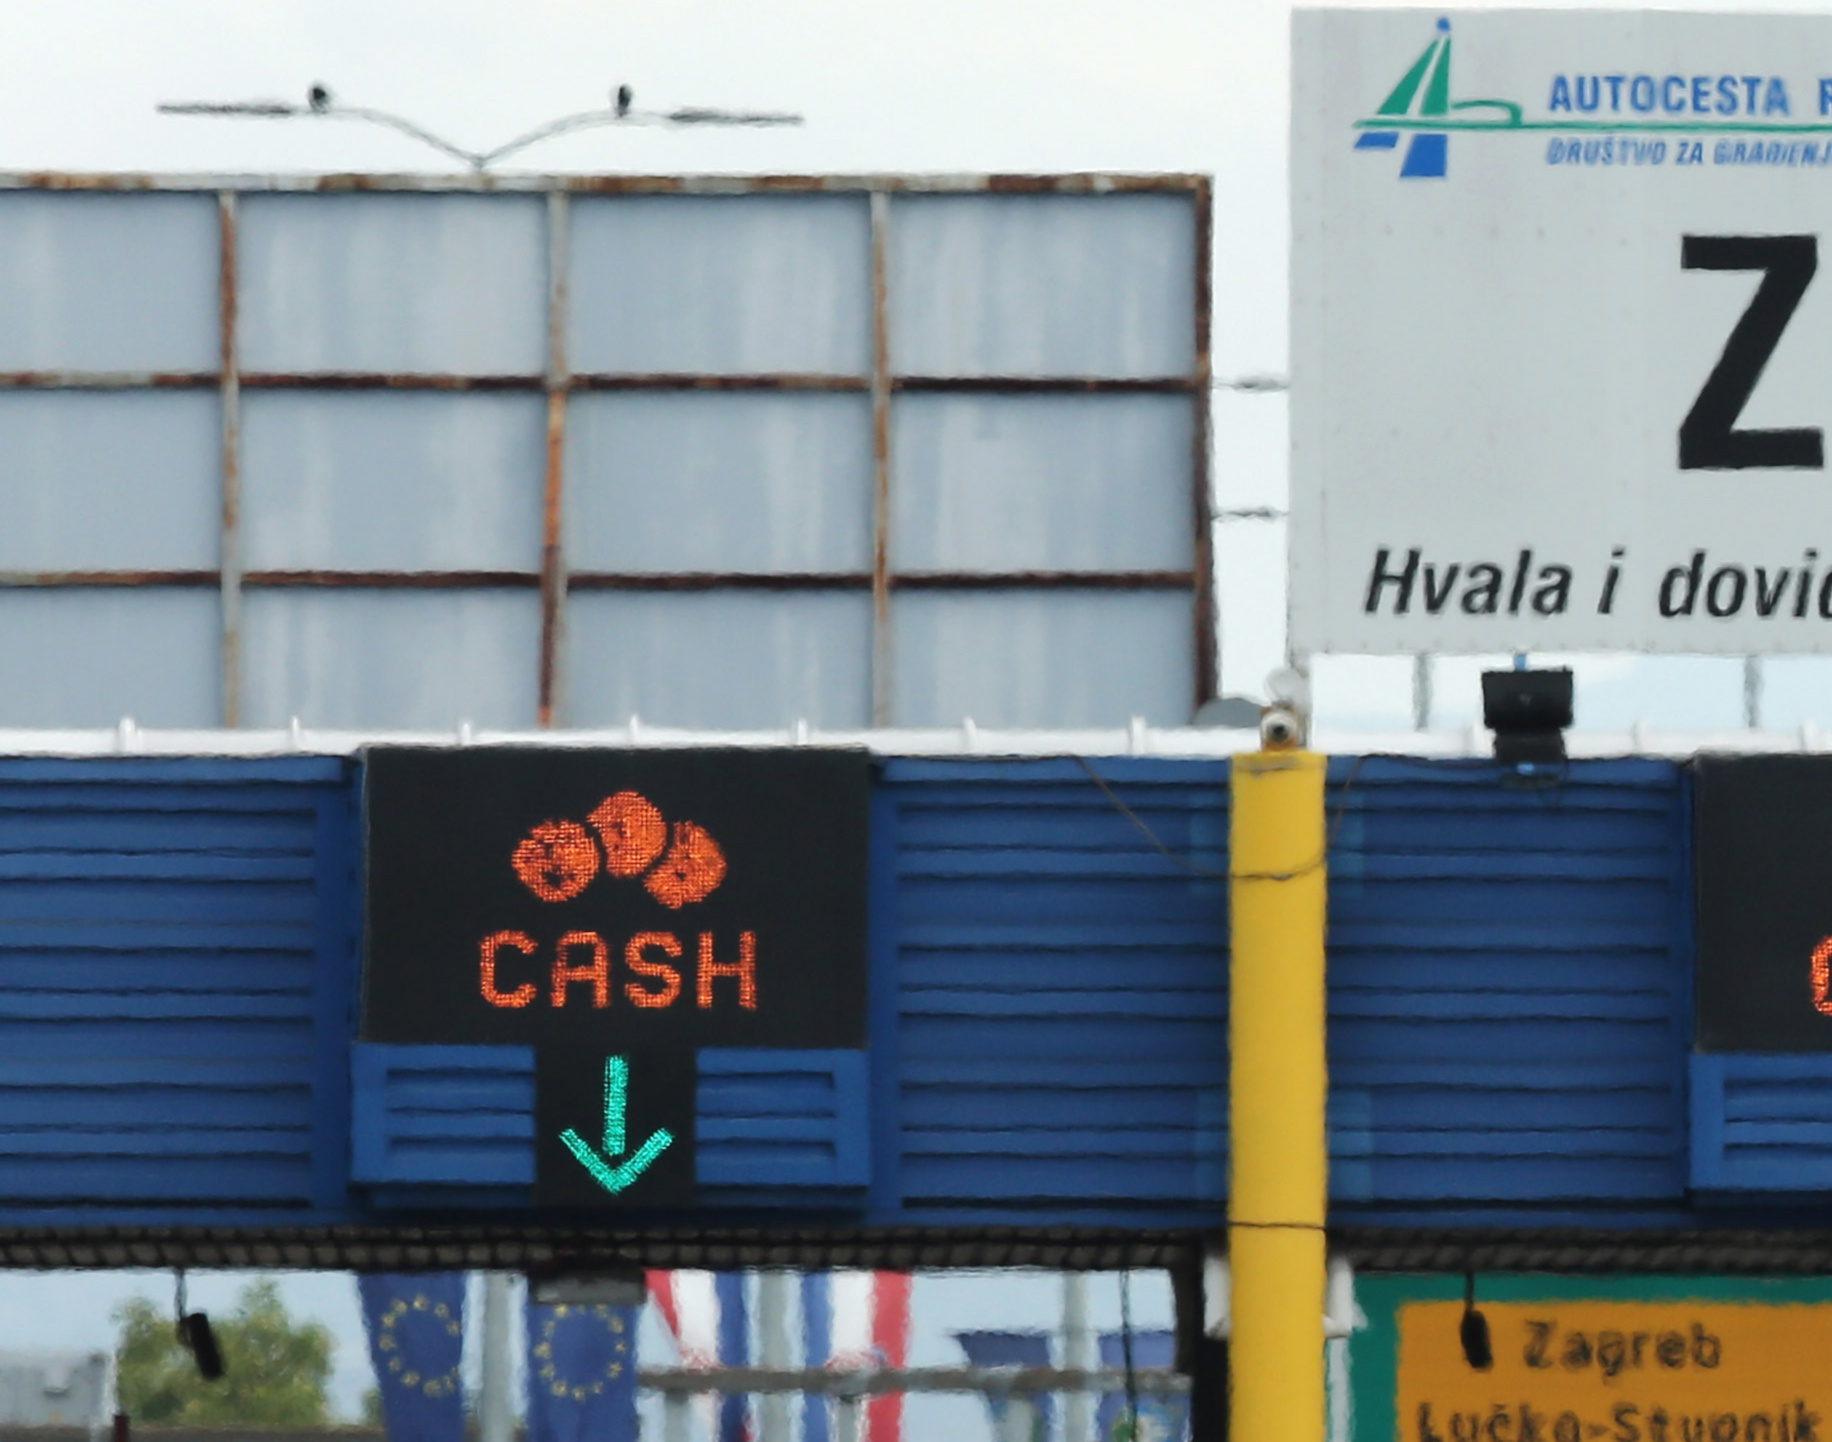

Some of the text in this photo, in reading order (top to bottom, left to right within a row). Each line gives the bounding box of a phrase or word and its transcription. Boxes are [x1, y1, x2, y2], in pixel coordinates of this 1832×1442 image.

[1548, 73, 1790, 116] AUTOCESTA
[1546, 136, 1667, 166] DRUŠTVO
[1675, 140, 1705, 167] ZA
[1365, 548, 1572, 617] Hvala
[1598, 549, 1624, 615] i
[479, 929, 758, 1010] CASH
[1521, 1317, 1722, 1381] Zagreb
